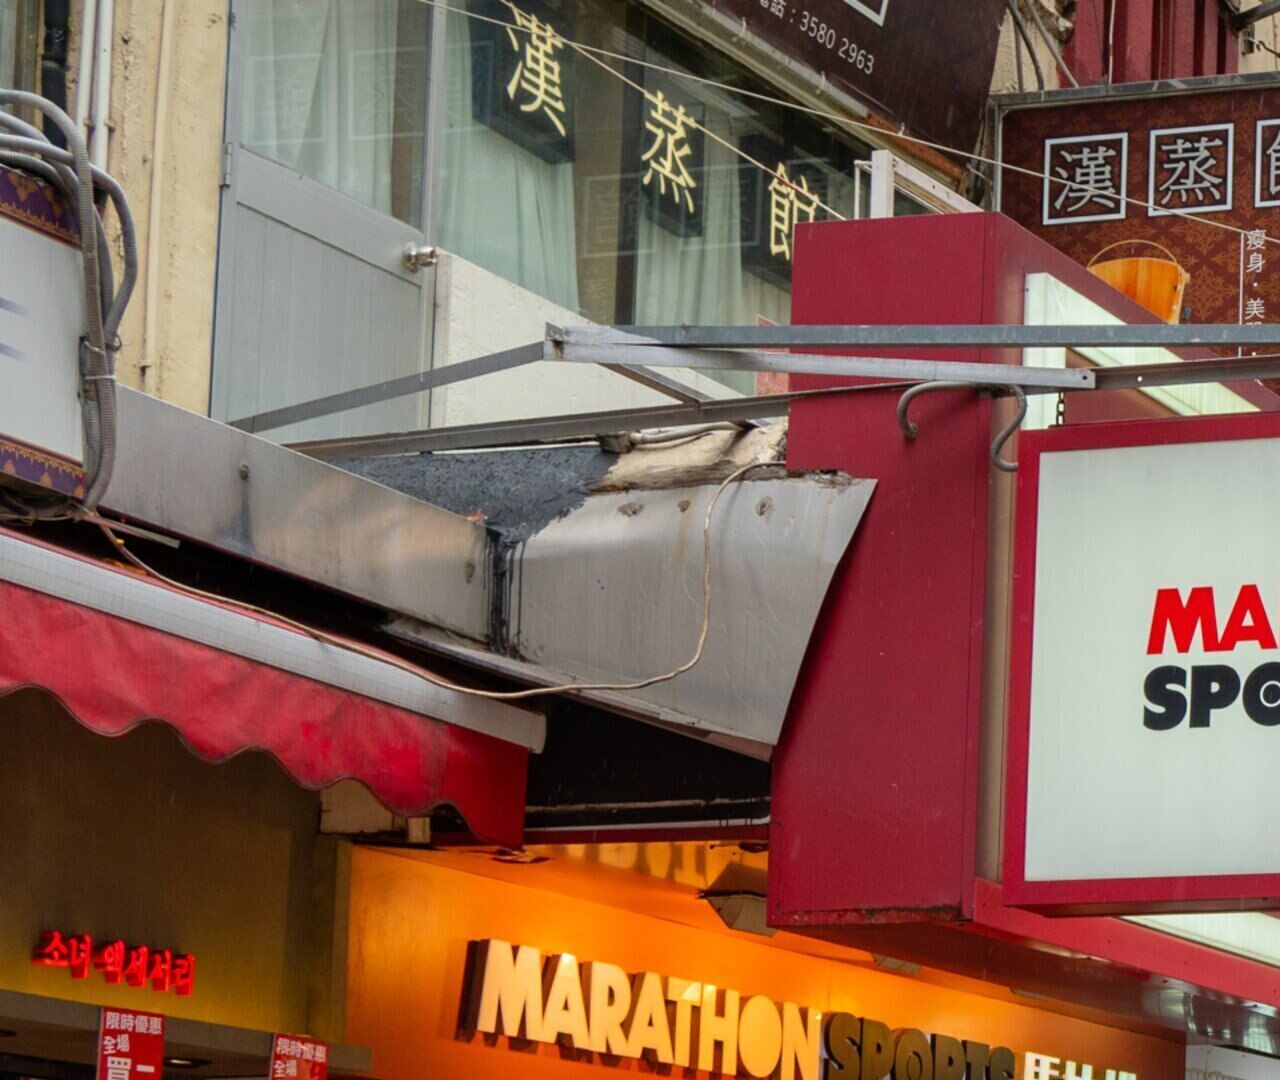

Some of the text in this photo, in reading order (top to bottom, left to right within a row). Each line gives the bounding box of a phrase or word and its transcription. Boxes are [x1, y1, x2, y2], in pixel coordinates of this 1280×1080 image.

[799, 11, 875, 74] 3580 2963
[105, 1011, 163, 1036] 限時優惠
[102, 1034, 131, 1056] 全場
